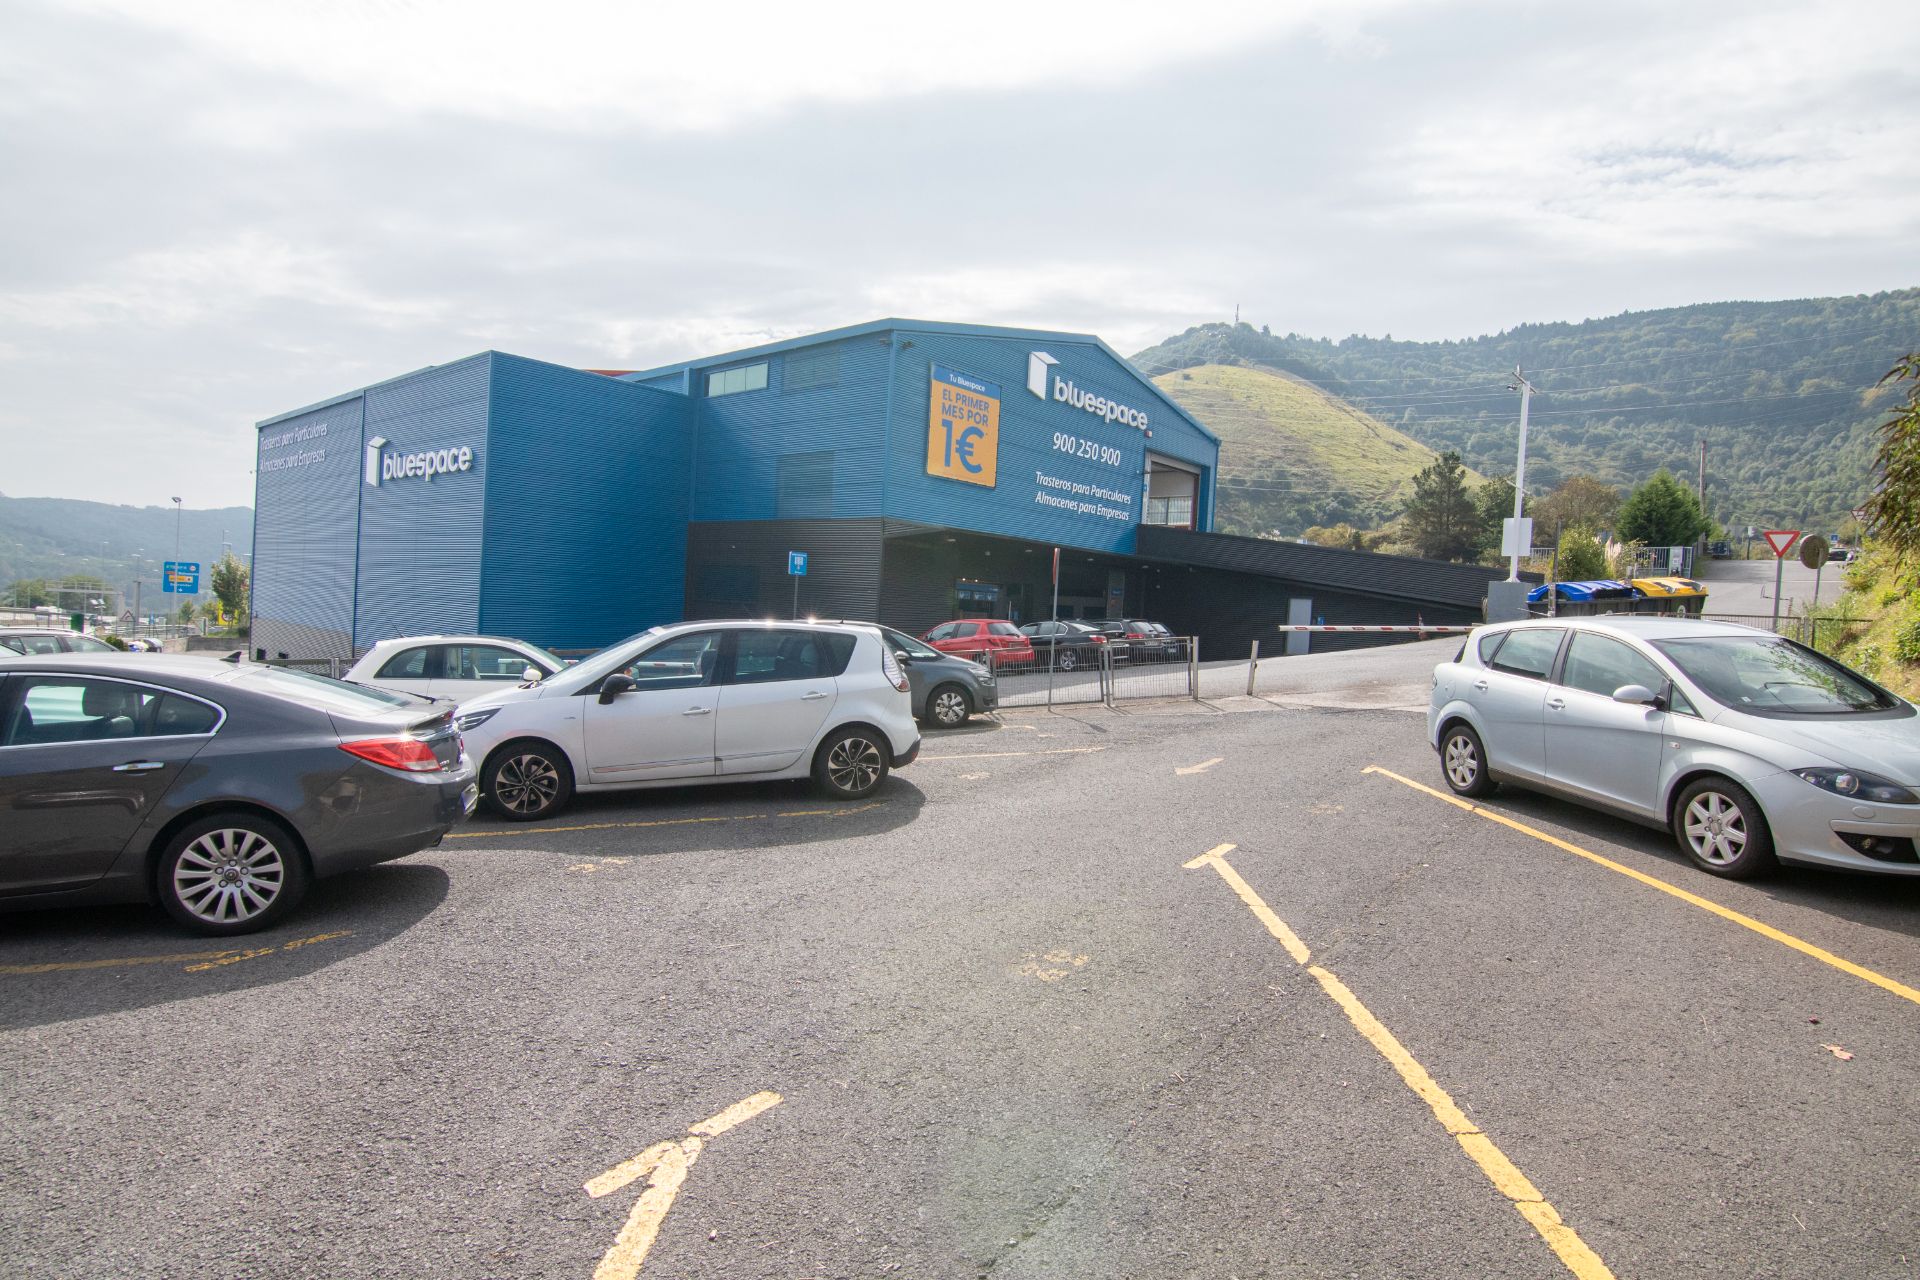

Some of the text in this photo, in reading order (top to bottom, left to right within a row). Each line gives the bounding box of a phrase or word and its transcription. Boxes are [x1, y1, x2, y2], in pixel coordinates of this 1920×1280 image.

[949, 374, 986, 392] Tu Bluespace
[941, 403, 989, 427] MES POR
[942, 388, 990, 413] EL PRIMER
[1053, 376, 1148, 430] bluespace
[383, 445, 472, 481] bluespace
[941, 418, 985, 474] 1€
[1053, 431, 1121, 467] 900 250 900
[1035, 471, 1131, 505] Trasteros para Particulares
[1035, 490, 1130, 521] Almacenes para Empresas
